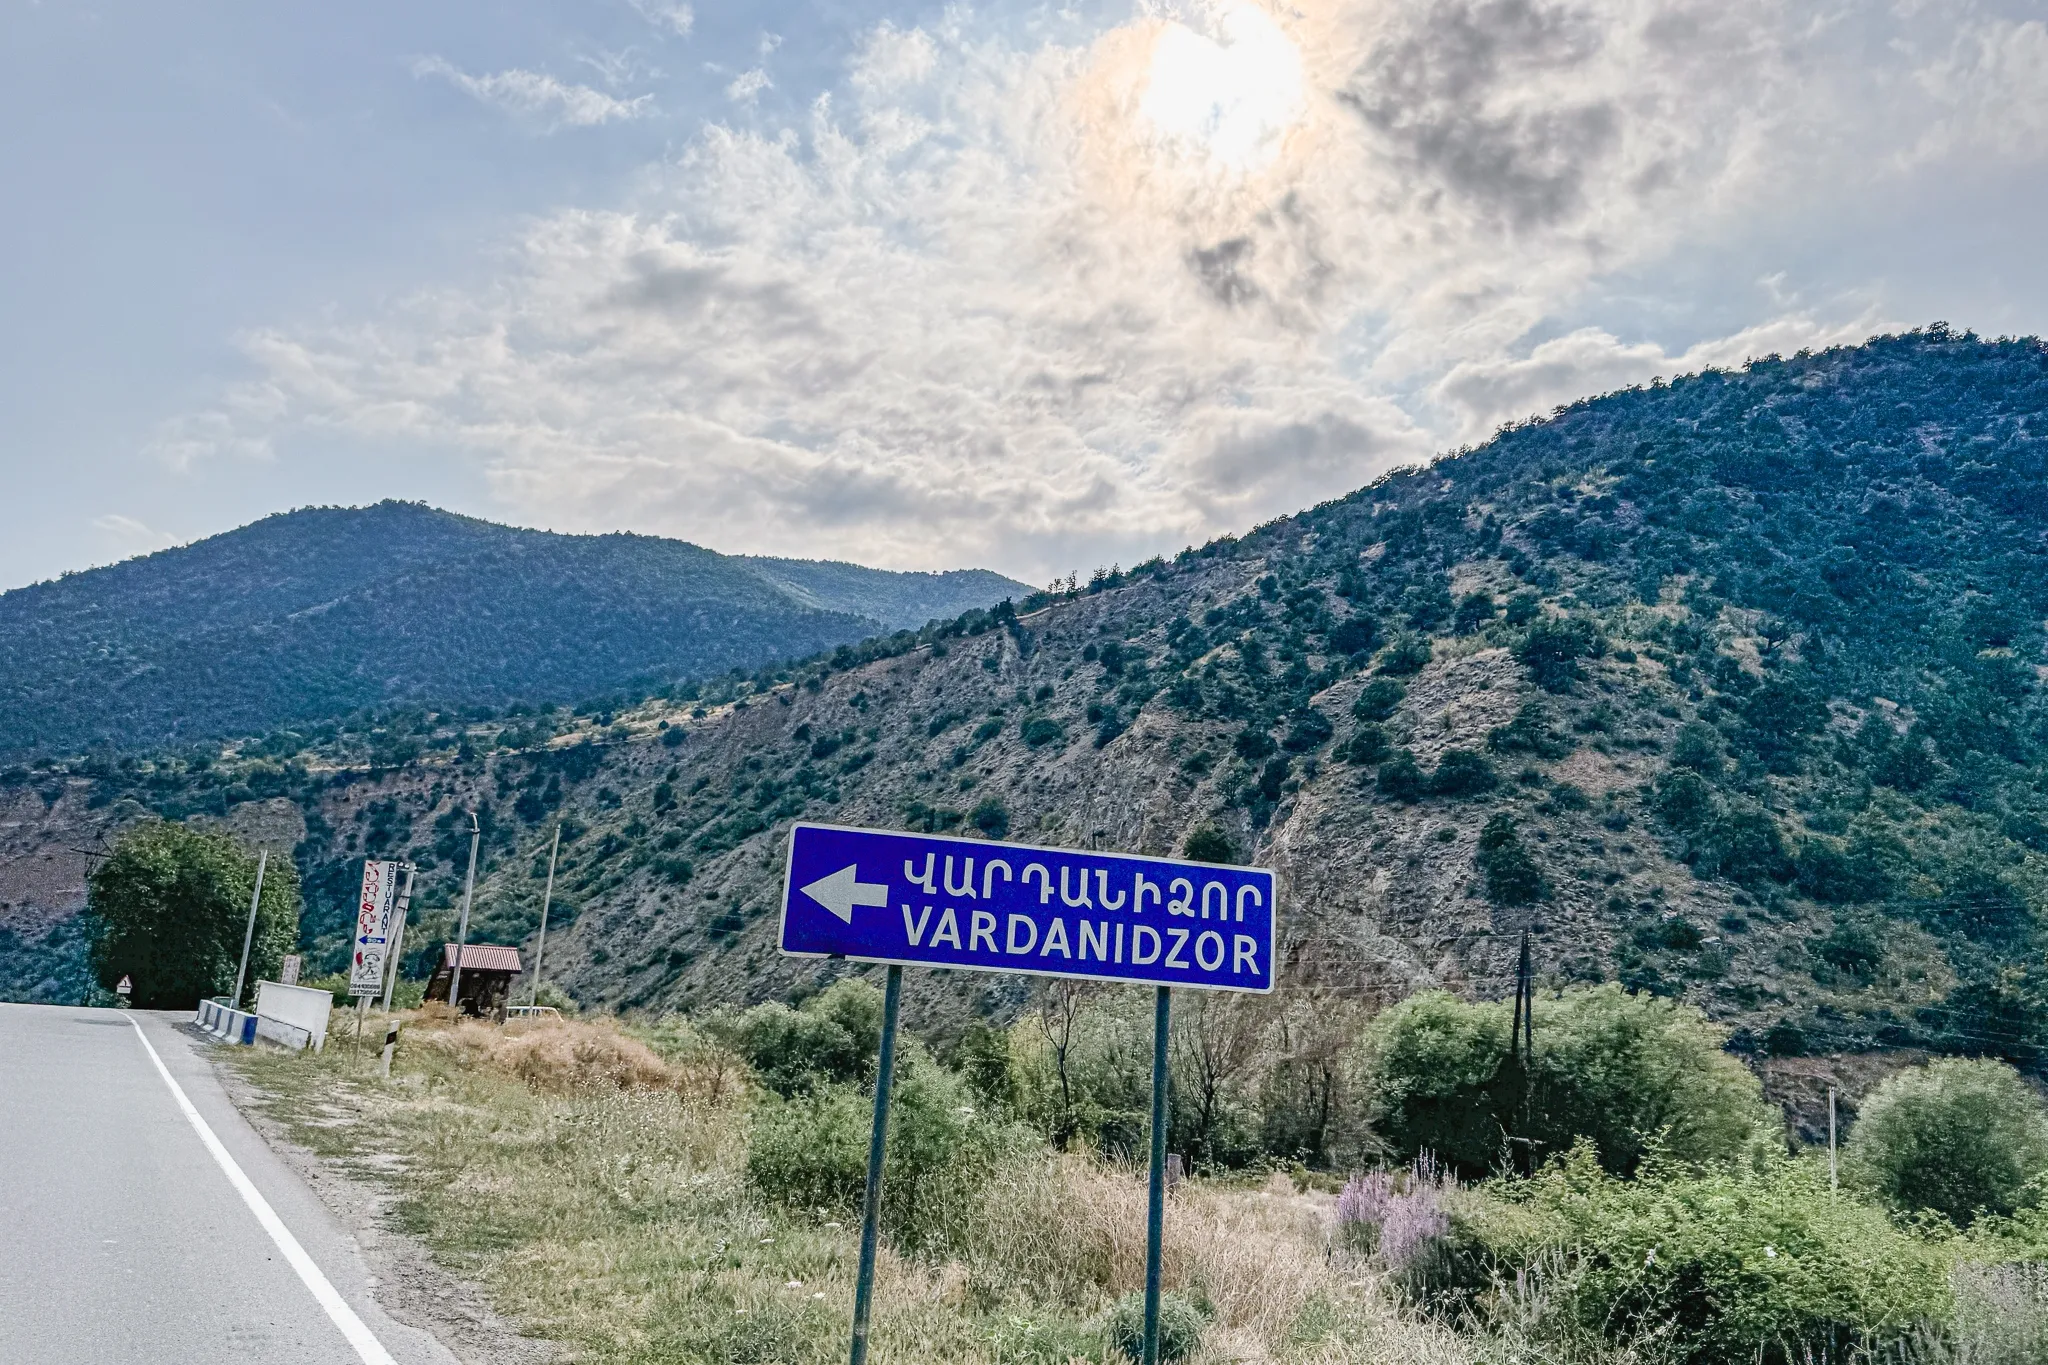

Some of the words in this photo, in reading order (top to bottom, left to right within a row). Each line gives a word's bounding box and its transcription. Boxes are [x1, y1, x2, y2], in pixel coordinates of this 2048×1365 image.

[381, 863, 396, 935] RESTUARANT
[904, 852, 1262, 922] ՎԱՐԴԱՆԻՁՈՐ
[901, 904, 1261, 975] VARDANIDZOR
